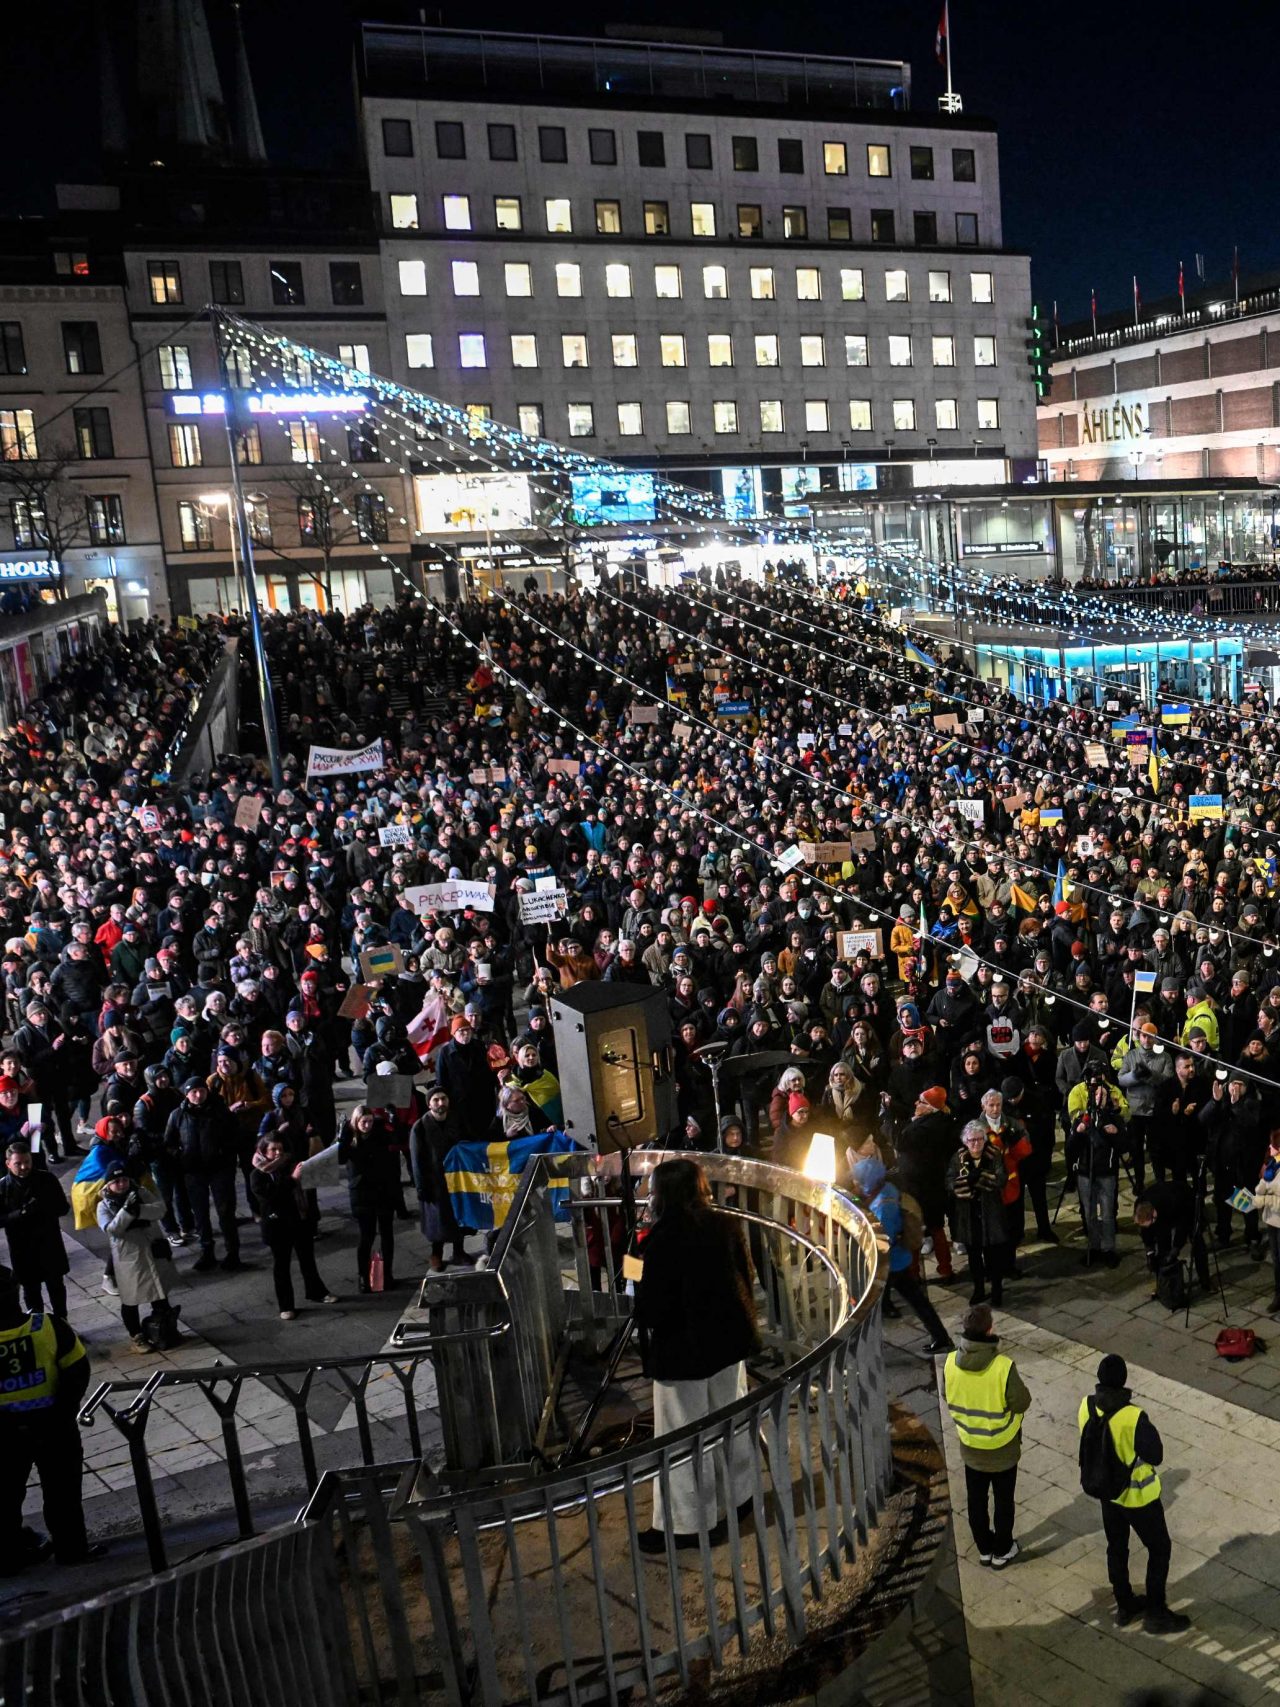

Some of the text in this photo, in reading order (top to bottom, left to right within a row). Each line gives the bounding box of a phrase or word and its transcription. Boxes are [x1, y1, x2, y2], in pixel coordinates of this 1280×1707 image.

[1082, 399, 1143, 445] ÅHLÉNS
[419, 891, 457, 907] PEACE
[8, 1358, 22, 1374] 3
